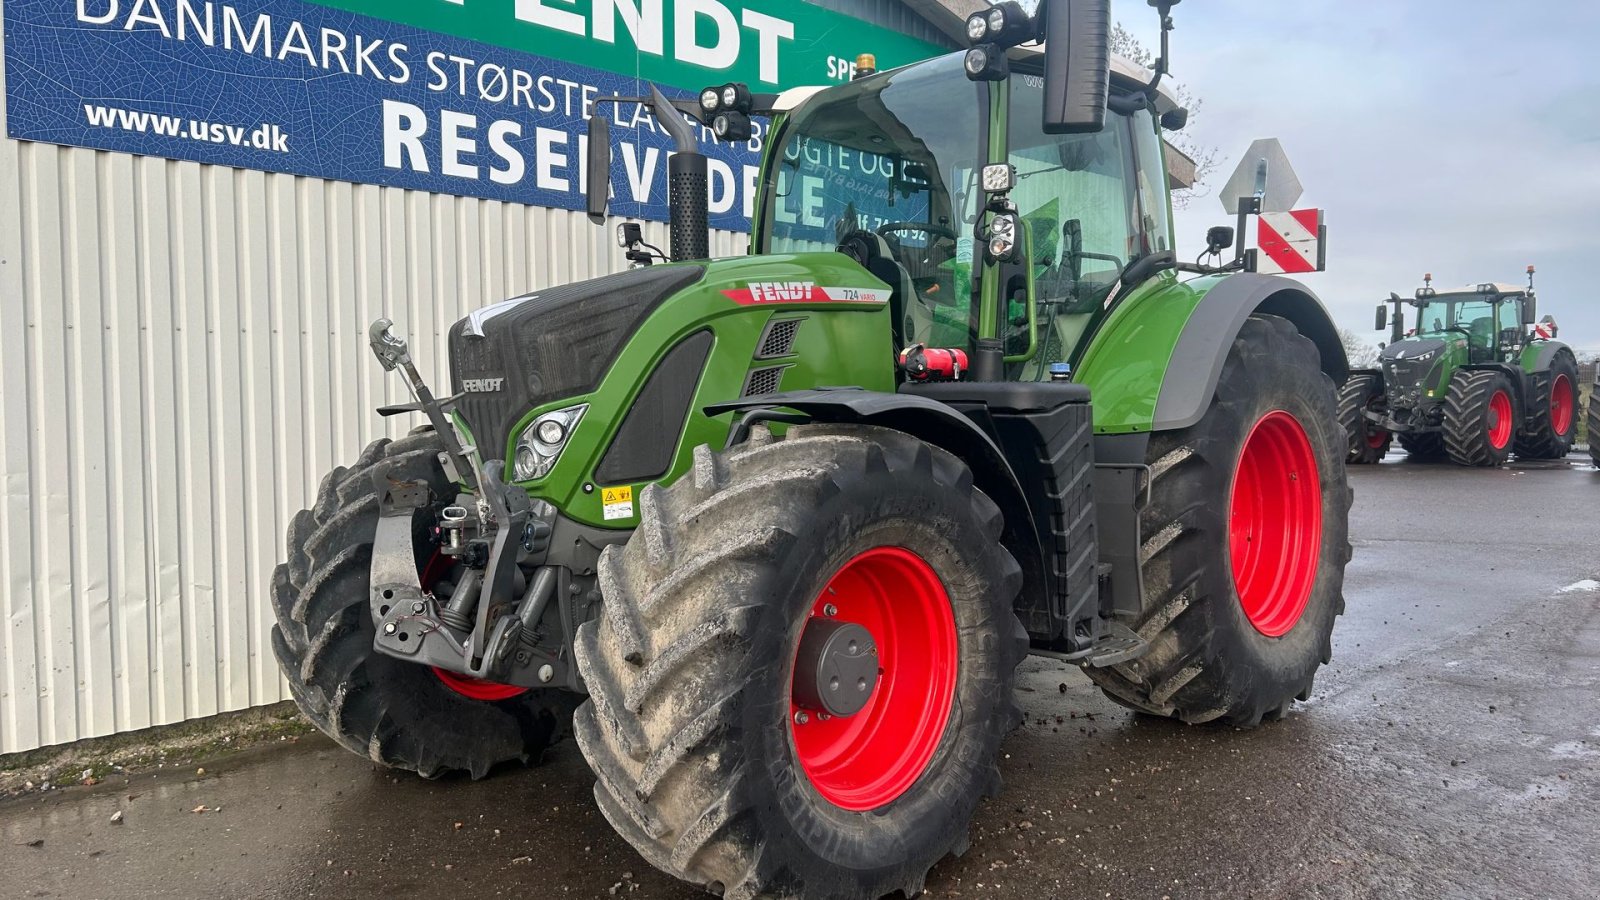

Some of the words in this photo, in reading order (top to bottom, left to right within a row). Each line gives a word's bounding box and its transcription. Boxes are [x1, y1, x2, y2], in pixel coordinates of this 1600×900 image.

[76, 0, 411, 84] DANMARKS
[427, 52, 599, 120] STØRSTE
[84, 104, 289, 154] www.usv.dk
[747, 281, 814, 301] FENDT
[843, 290, 859, 300] 724
[860, 293, 876, 301] VARIO
[462, 377, 504, 393] FENDT
